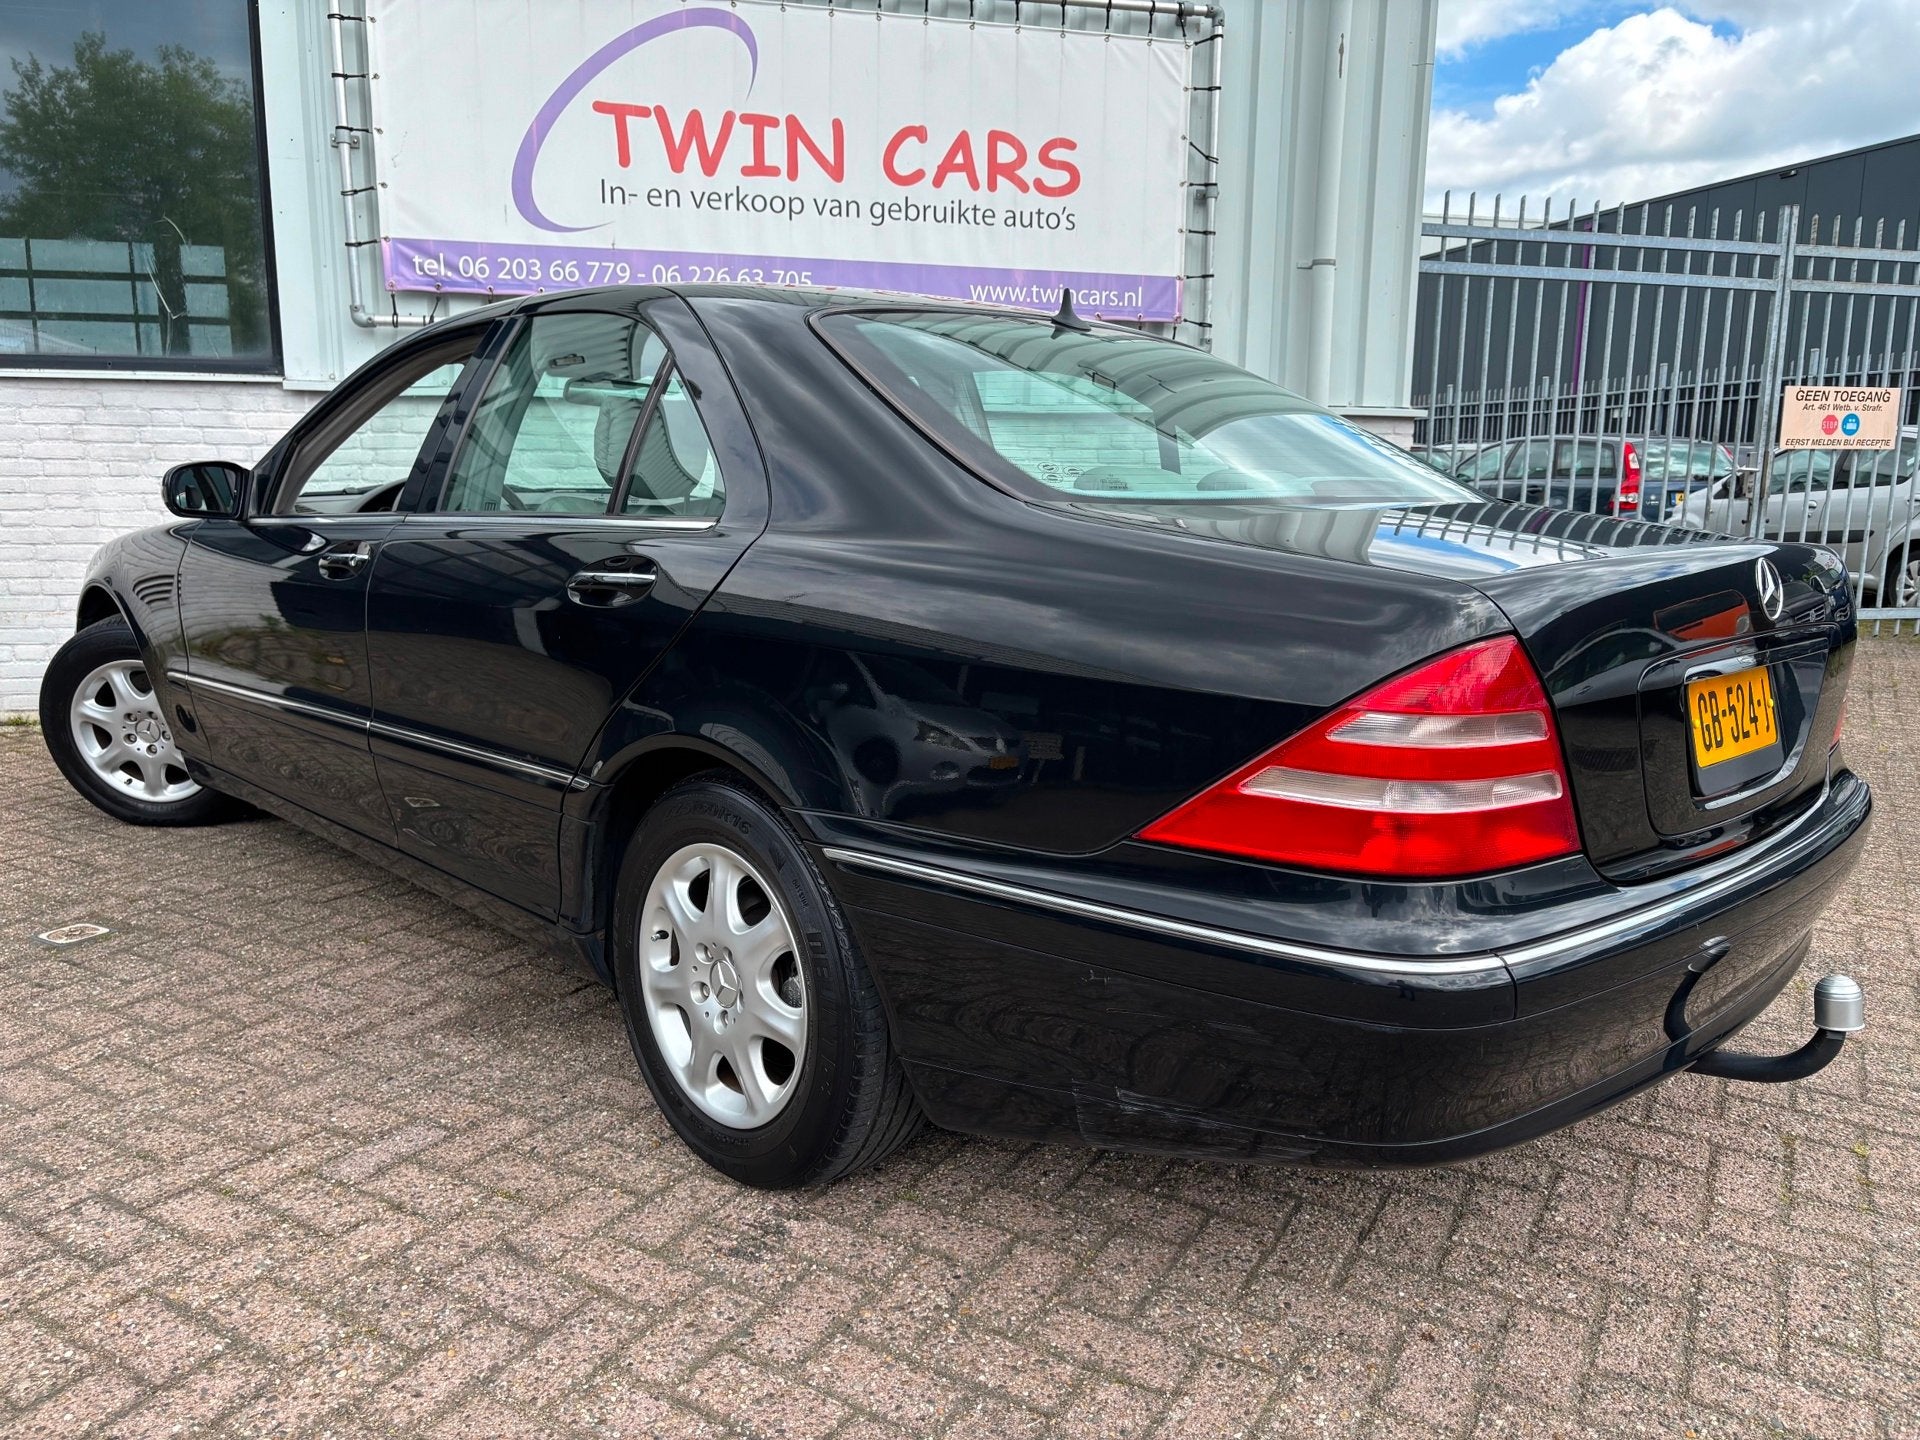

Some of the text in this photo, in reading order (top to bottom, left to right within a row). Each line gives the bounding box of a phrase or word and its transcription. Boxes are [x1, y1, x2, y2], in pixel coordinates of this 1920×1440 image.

[592, 99, 1081, 197] TWIN CARS
[601, 178, 1076, 231] In- en verkoop van gebruikte auto's
[412, 253, 453, 277] tel.
[458, 255, 490, 279] 06
[497, 257, 542, 280] 203
[550, 260, 580, 282] 66
[586, 261, 631, 284] 779
[652, 264, 682, 284] 06
[688, 266, 730, 283] 226
[737, 268, 764, 284] 63
[772, 270, 812, 286] 705
[969, 284, 1142, 307] www.twincars.nl
[1795, 390, 1891, 402] GEEN TOEGANG
[1802, 403, 1815, 411] Art.
[1832, 404, 1852, 412] Wetb.
[1862, 404, 1883, 412] Strafr.
[1822, 420, 1837, 429] STOP
[1785, 438, 1809, 446] EERST
[1843, 439, 1857, 447] BIJ
[1856, 439, 1891, 447] RECEPTIE
